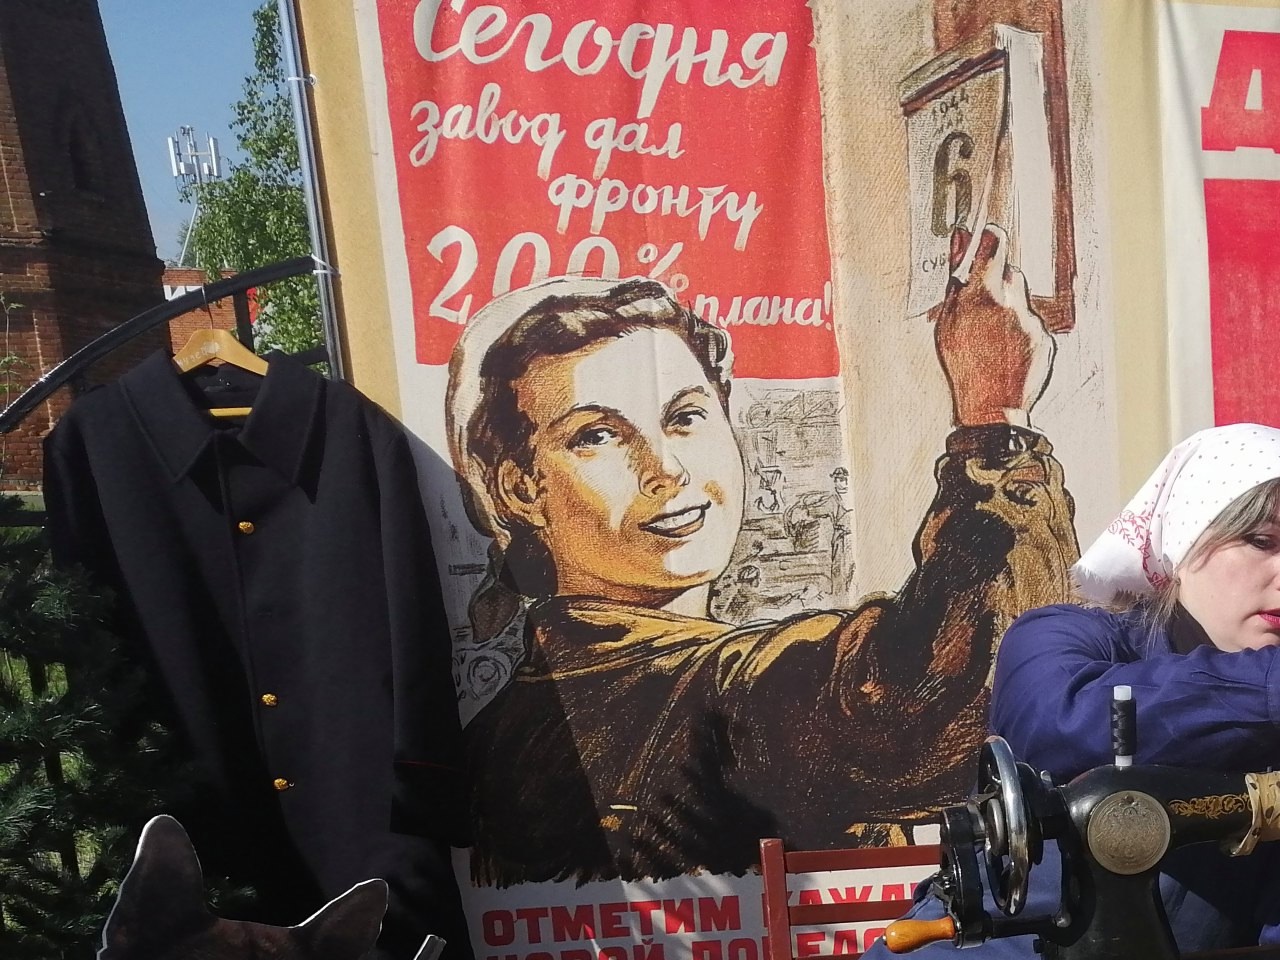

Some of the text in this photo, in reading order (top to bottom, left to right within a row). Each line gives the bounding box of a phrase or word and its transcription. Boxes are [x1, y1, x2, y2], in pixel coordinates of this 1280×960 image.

[413, 0, 788, 118] Сегодня
[409, 83, 685, 180] завод дал
[549, 173, 763, 251] фронту
[695, 281, 833, 330] плана!
[482, 895, 742, 947] ОТМЕТИМ
